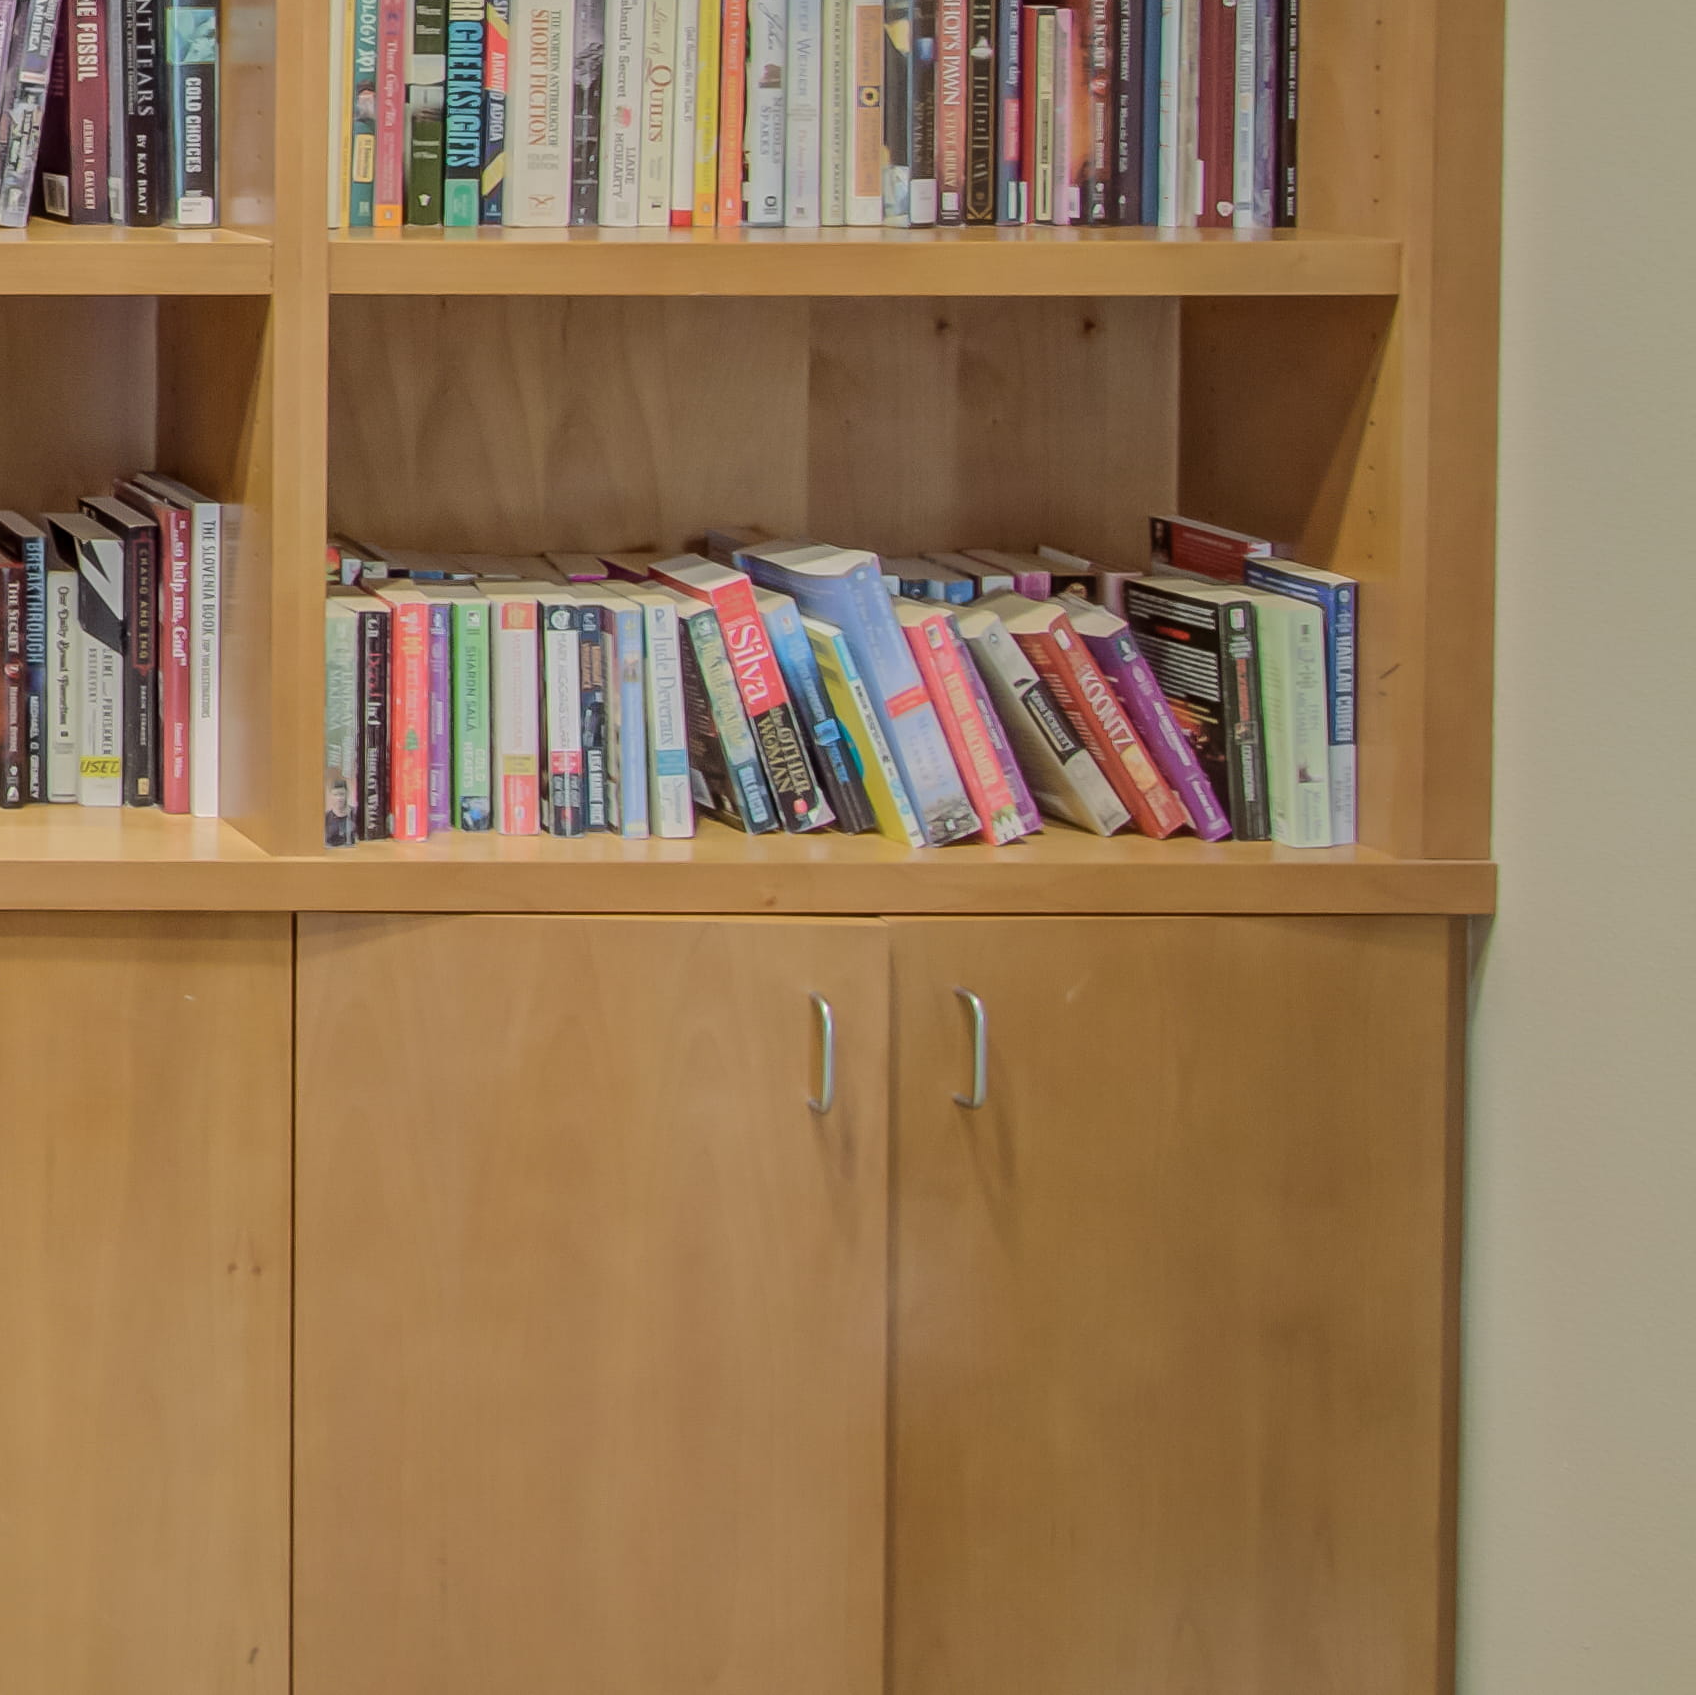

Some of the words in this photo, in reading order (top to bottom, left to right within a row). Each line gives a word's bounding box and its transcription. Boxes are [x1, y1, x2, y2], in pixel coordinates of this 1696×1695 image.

[77, 23, 98, 81] FOSSIL
[447, 21, 483, 109] GREEKS
[529, 9, 548, 68] SHORT
[136, 39, 155, 115] TEARS
[185, 77, 201, 110] COLD
[447, 115, 480, 166] GIFTS
[528, 73, 547, 146] FICTION
[185, 115, 202, 172] CHOICES
[25, 542, 45, 663] BREAKTHROUGH
[465, 646, 476, 696] SHARON
[725, 623, 771, 704] Silva
[465, 700, 476, 731] SALA
[757, 717, 793, 793] WOMAN
[774, 726, 811, 796] OTHER
